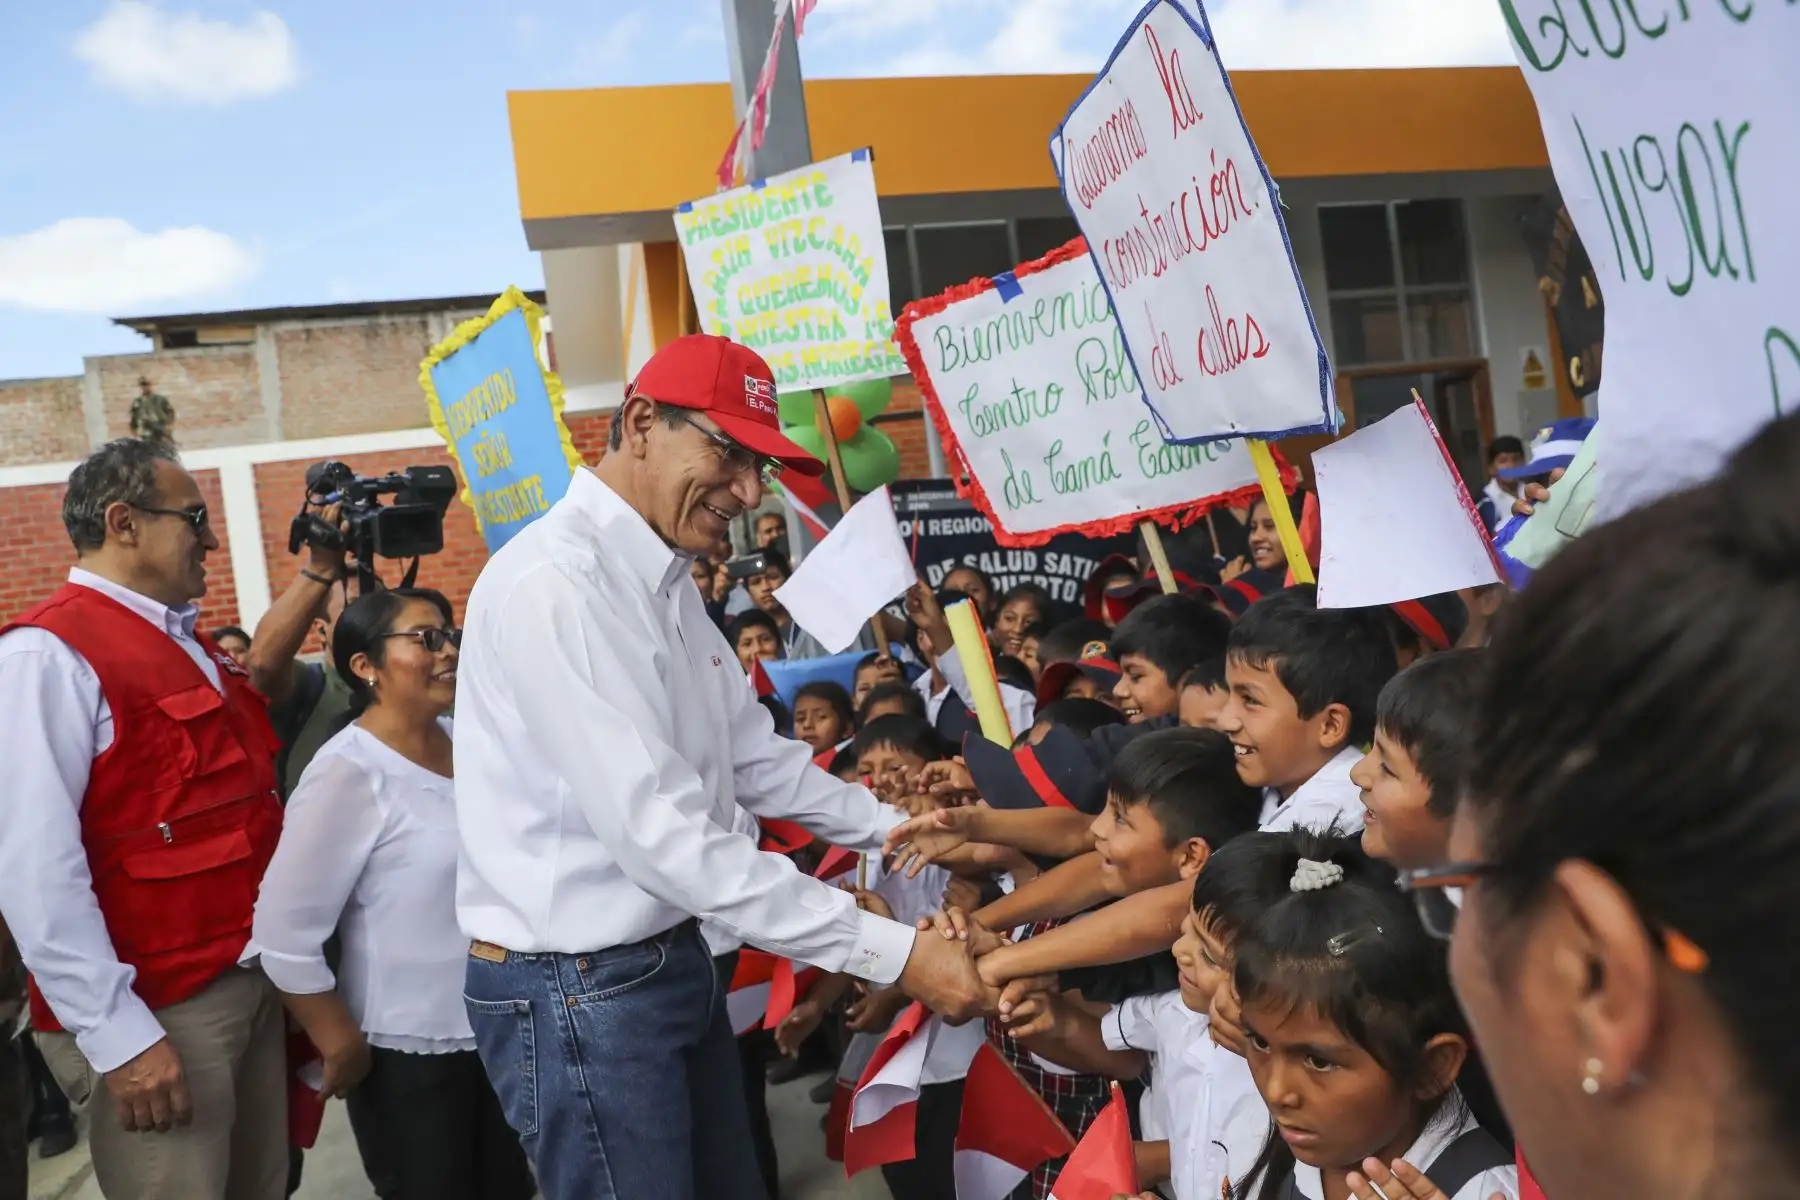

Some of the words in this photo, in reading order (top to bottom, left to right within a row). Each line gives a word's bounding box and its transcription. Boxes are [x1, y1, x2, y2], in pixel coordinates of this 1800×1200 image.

[1144, 23, 1203, 140] la
[681, 171, 834, 246] PRESIDENTE
[1571, 111, 1757, 298] lugar
[735, 306, 848, 348] NUESTRA
[737, 262, 865, 317] QUEREMOS
[933, 280, 1115, 373] Bienvenid
[1145, 300, 1183, 391] de
[1197, 284, 1271, 377] aulas
[959, 377, 1064, 438] Centro
[1001, 448, 1043, 511] de
[1044, 430, 1122, 494] Caná
[963, 550, 1038, 574] SALUD
[1044, 551, 1101, 581] SATI
